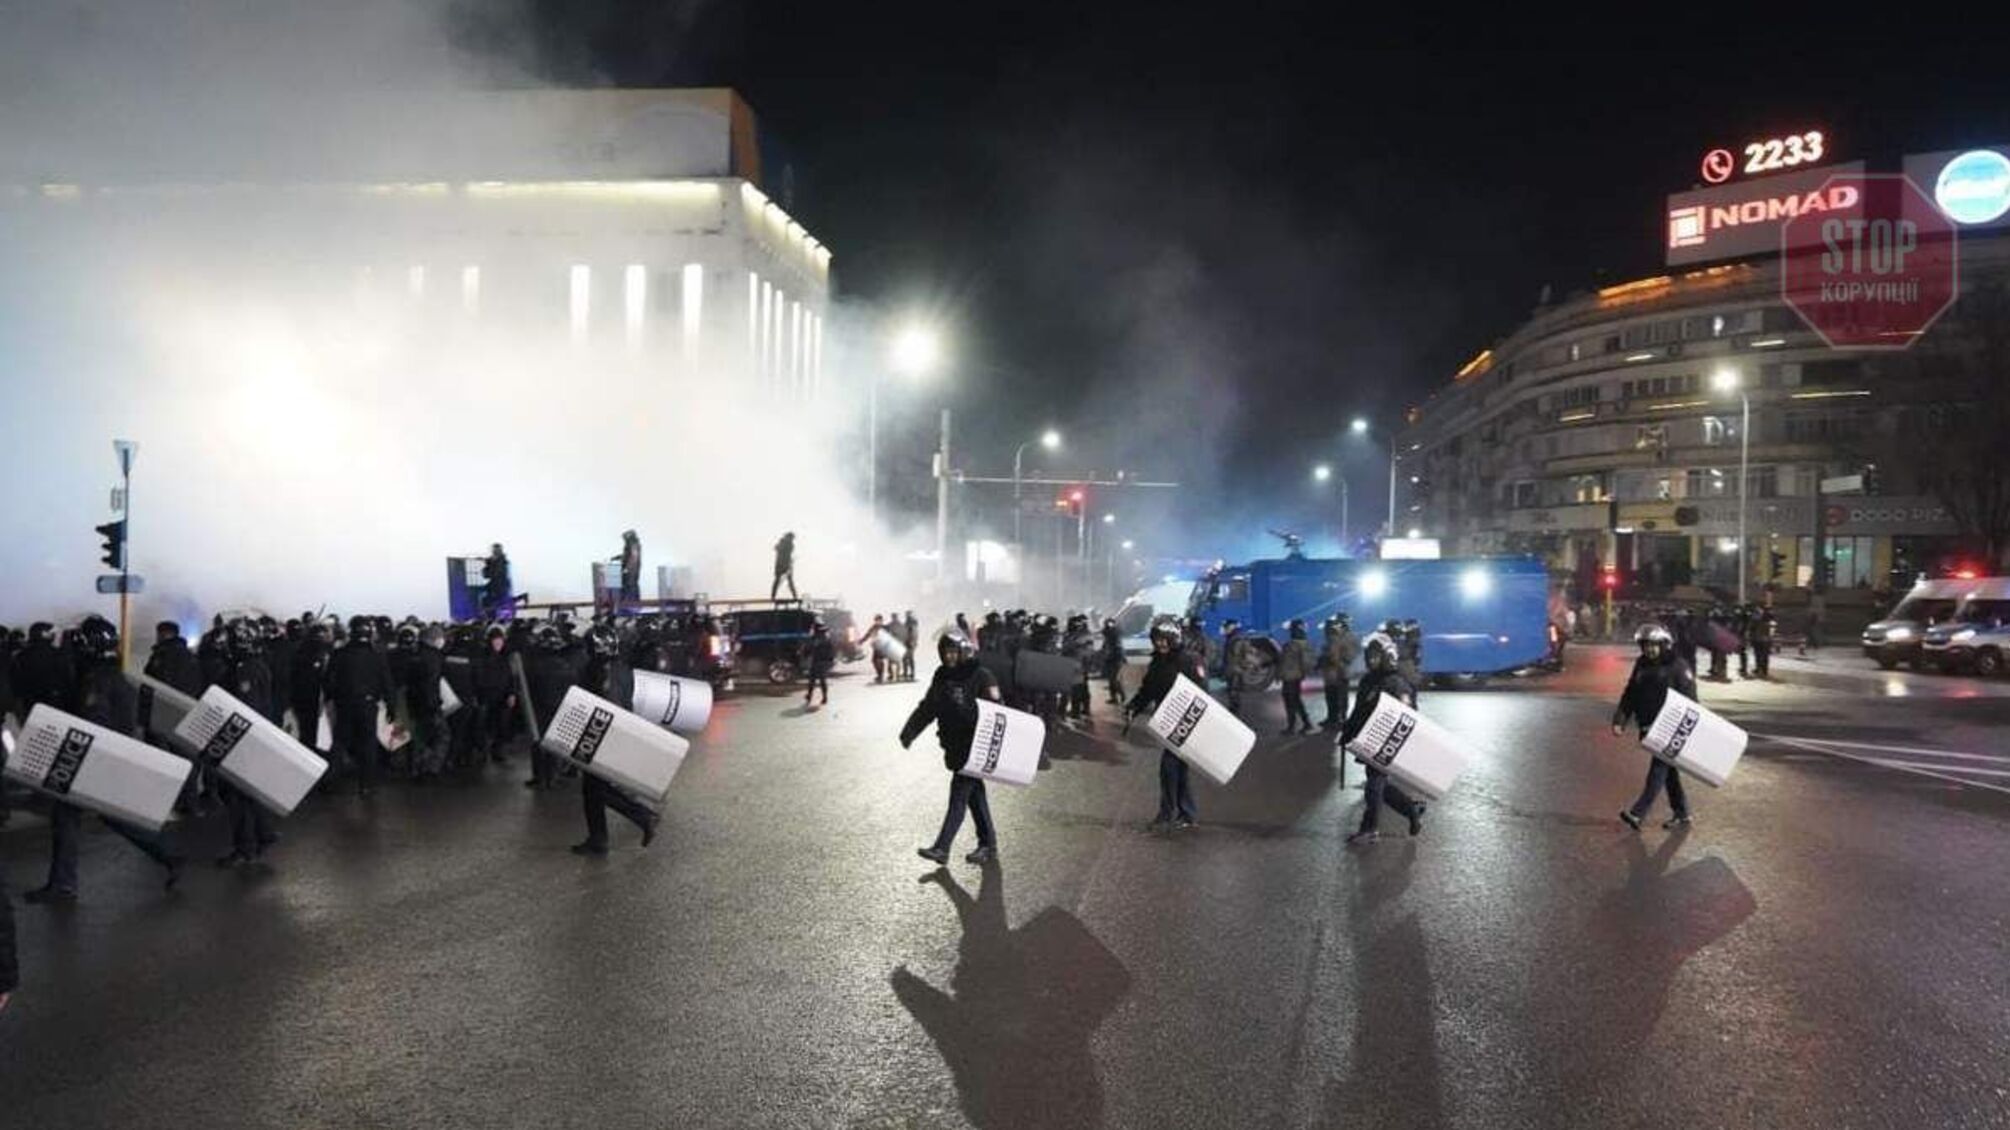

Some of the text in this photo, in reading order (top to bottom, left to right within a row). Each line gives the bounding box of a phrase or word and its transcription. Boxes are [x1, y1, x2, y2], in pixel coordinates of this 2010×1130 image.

[1744, 131, 1823, 173] 2233
[1711, 186, 1859, 229] NOMAD
[574, 708, 612, 762] POLICE
[983, 714, 1006, 771] POLICE
[1169, 698, 1207, 746] POLICE
[1375, 713, 1415, 764] POLICE
[1664, 709, 1699, 756] POLICE
[46, 730, 91, 791] POLICE
